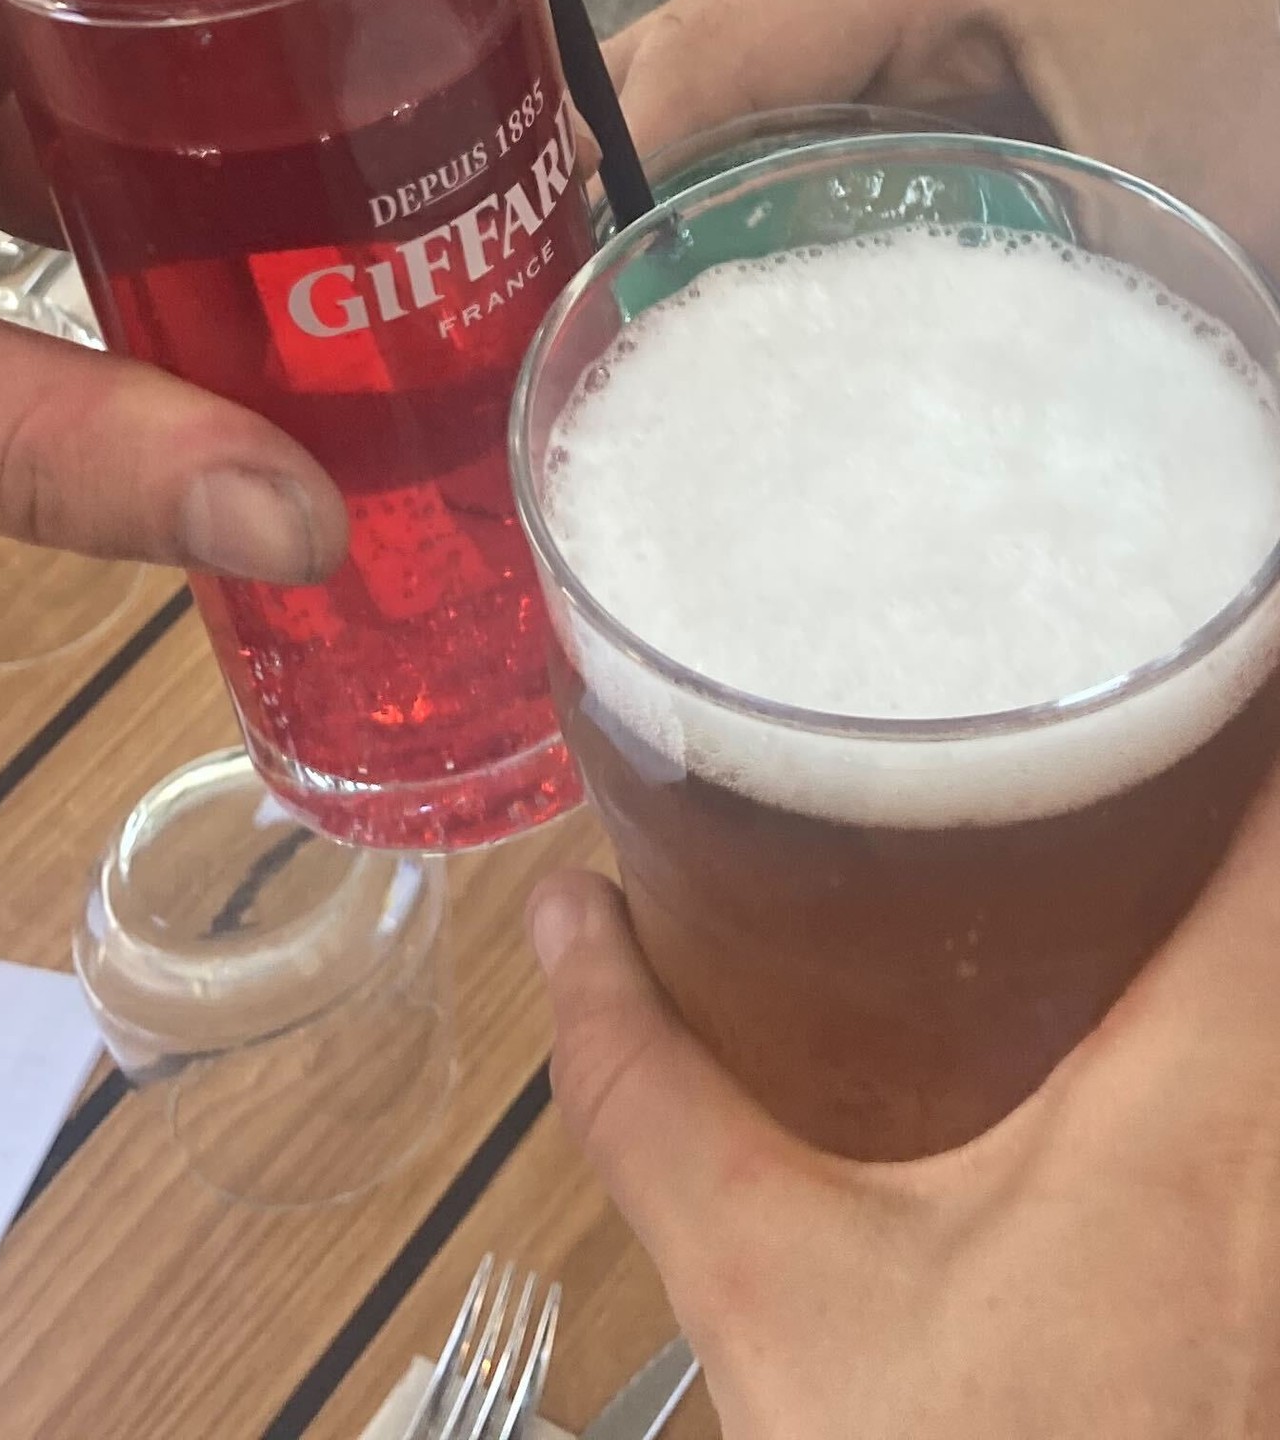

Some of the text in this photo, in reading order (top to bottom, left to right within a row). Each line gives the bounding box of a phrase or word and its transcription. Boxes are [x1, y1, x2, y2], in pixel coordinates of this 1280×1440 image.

[368, 77, 544, 228] DEPUIS 1885
[438, 239, 555, 339] FRANCE
